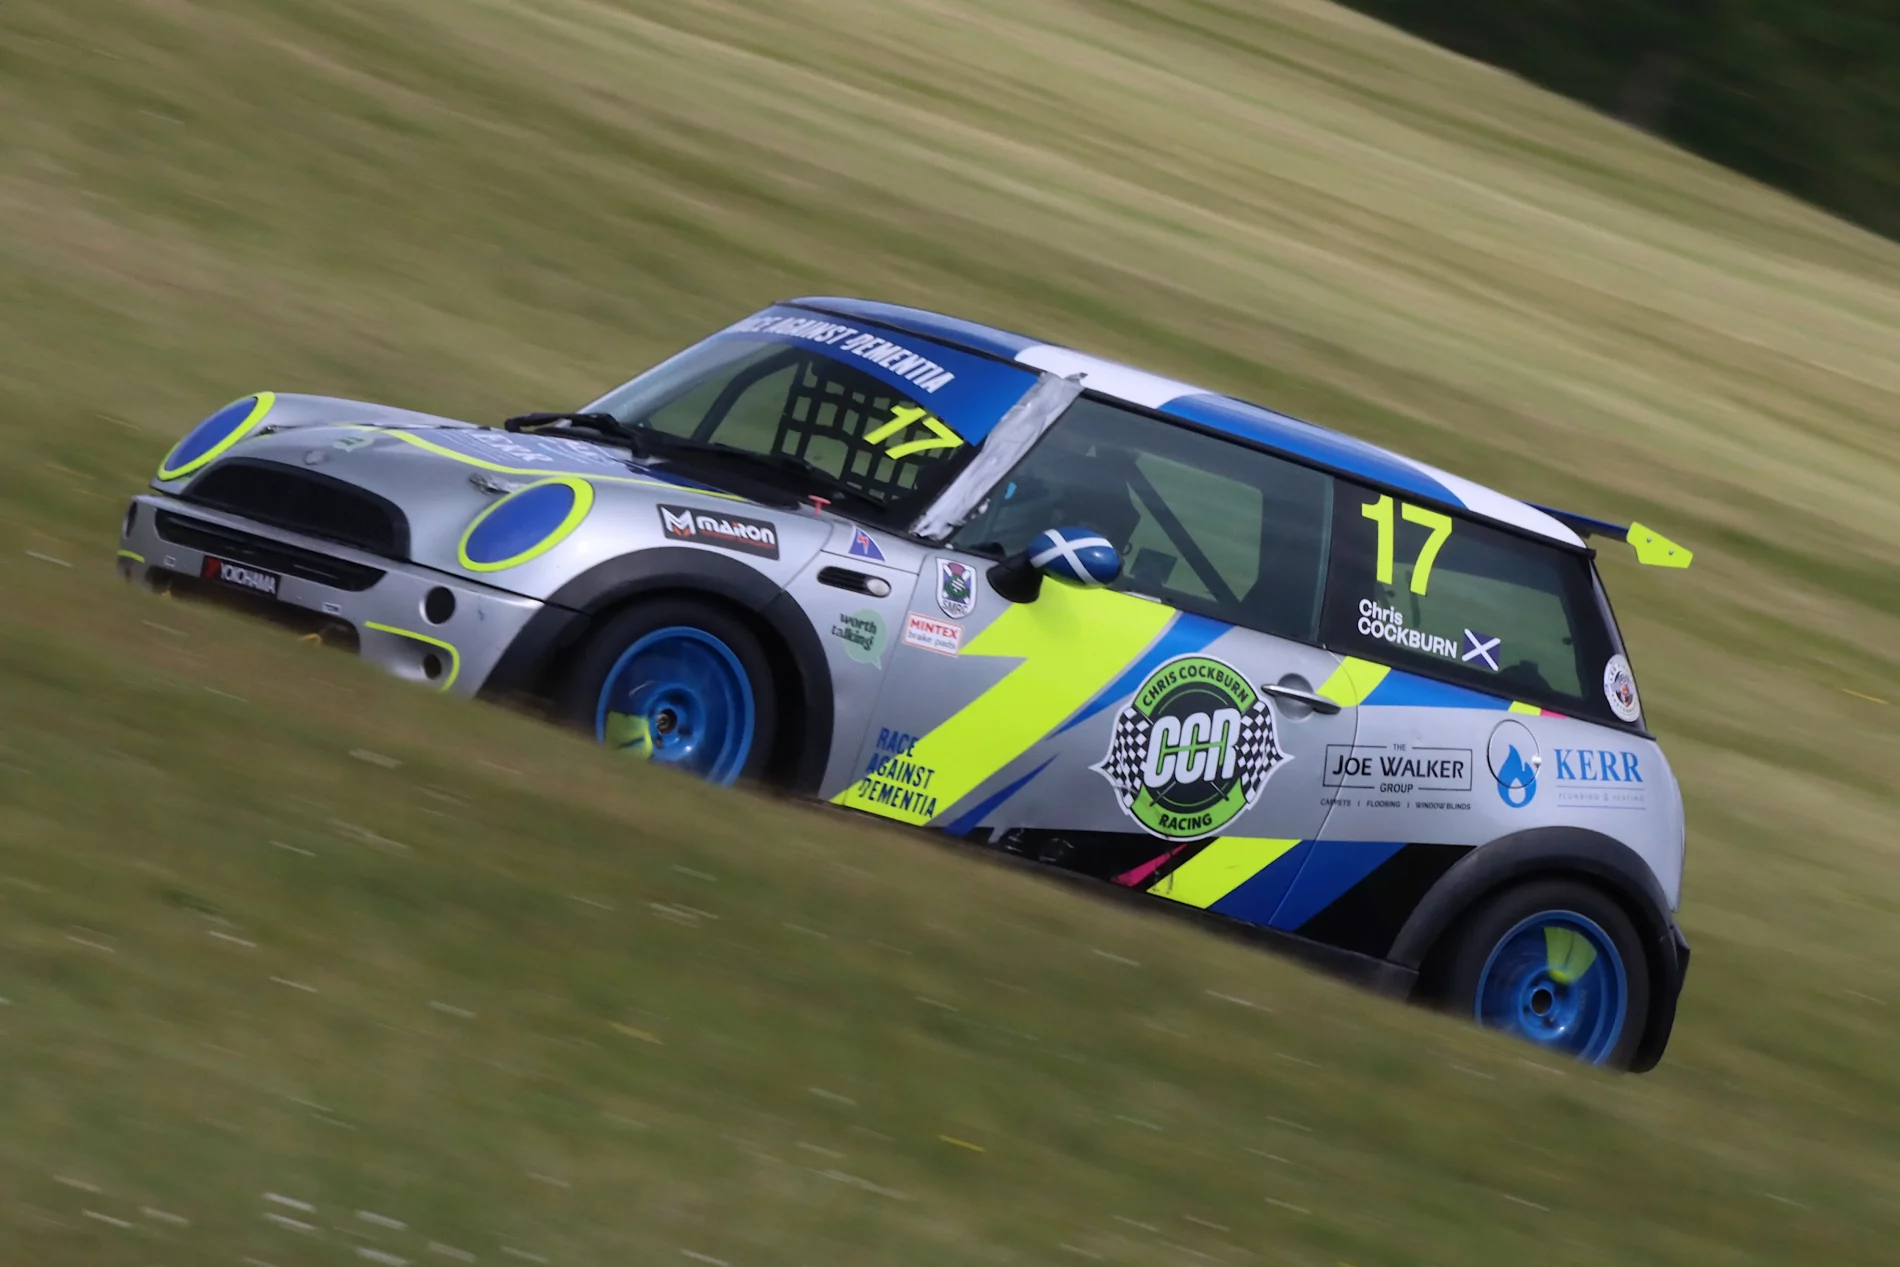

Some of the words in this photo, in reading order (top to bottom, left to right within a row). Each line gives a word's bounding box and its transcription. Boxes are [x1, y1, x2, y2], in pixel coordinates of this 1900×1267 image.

[762, 316, 859, 345] AGAINST
[840, 332, 956, 394] DEMENTIA
[863, 405, 964, 460] 17
[1361, 493, 1453, 596] 17
[840, 612, 877, 635] worth
[1358, 599, 1403, 626] Chris
[831, 625, 874, 651] talking
[908, 631, 932, 644] brake
[934, 637, 956, 650] pads
[910, 619, 958, 640] MINTEX
[1357, 617, 1458, 659] COCKBURN
[1142, 671, 1178, 707] CHRIS
[1179, 665, 1250, 704] COCKBURN
[876, 726, 920, 758] RACE
[1143, 707, 1243, 789] CCR
[1393, 743, 1407, 752] THE
[865, 752, 936, 789] AGAINST
[1332, 754, 1373, 777] JOE
[1379, 756, 1465, 780] WALKER
[1553, 748, 1644, 783] KERR
[858, 777, 938, 819] DEMENTIA
[1379, 783, 1414, 794] GROUP
[1366, 800, 1401, 809] FLOORING
[1415, 801, 1445, 810] WINDOW
[1446, 802, 1471, 811] BLINDS
[1158, 812, 1213, 831] RACING
